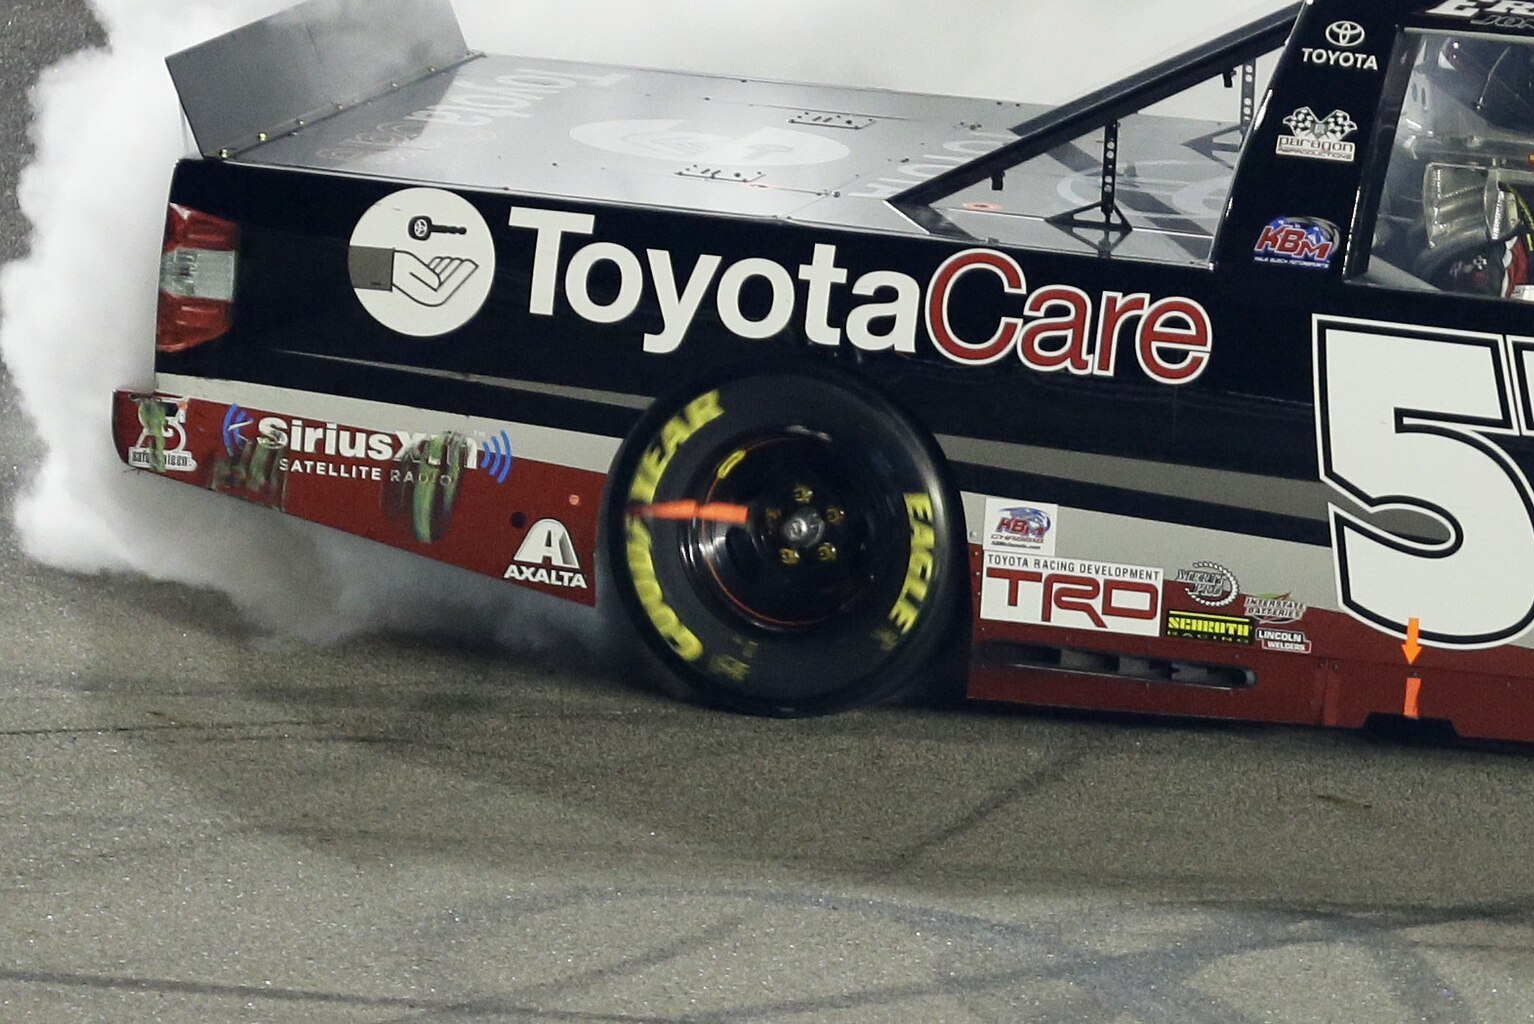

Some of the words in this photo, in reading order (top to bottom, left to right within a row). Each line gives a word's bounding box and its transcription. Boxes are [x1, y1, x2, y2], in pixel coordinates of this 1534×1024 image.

[1301, 47, 1378, 71] TOYOTA
[1279, 136, 1353, 152] paragon
[1254, 224, 1333, 261] KBM
[507, 206, 1213, 385] ToyotaCare
[279, 458, 381, 481] SATELLITE
[390, 469, 452, 487] RADIO
[503, 564, 588, 589] AXALTA
[987, 554, 1029, 567] TOYOTA
[1033, 559, 1075, 573] RACING
[1079, 563, 1161, 581] DEVELOPMENT
[986, 566, 1159, 629] TRD
[1168, 617, 1250, 636] SCHROTH
[1258, 630, 1302, 643] LINCOLN
[1267, 641, 1305, 651] WELDERS
